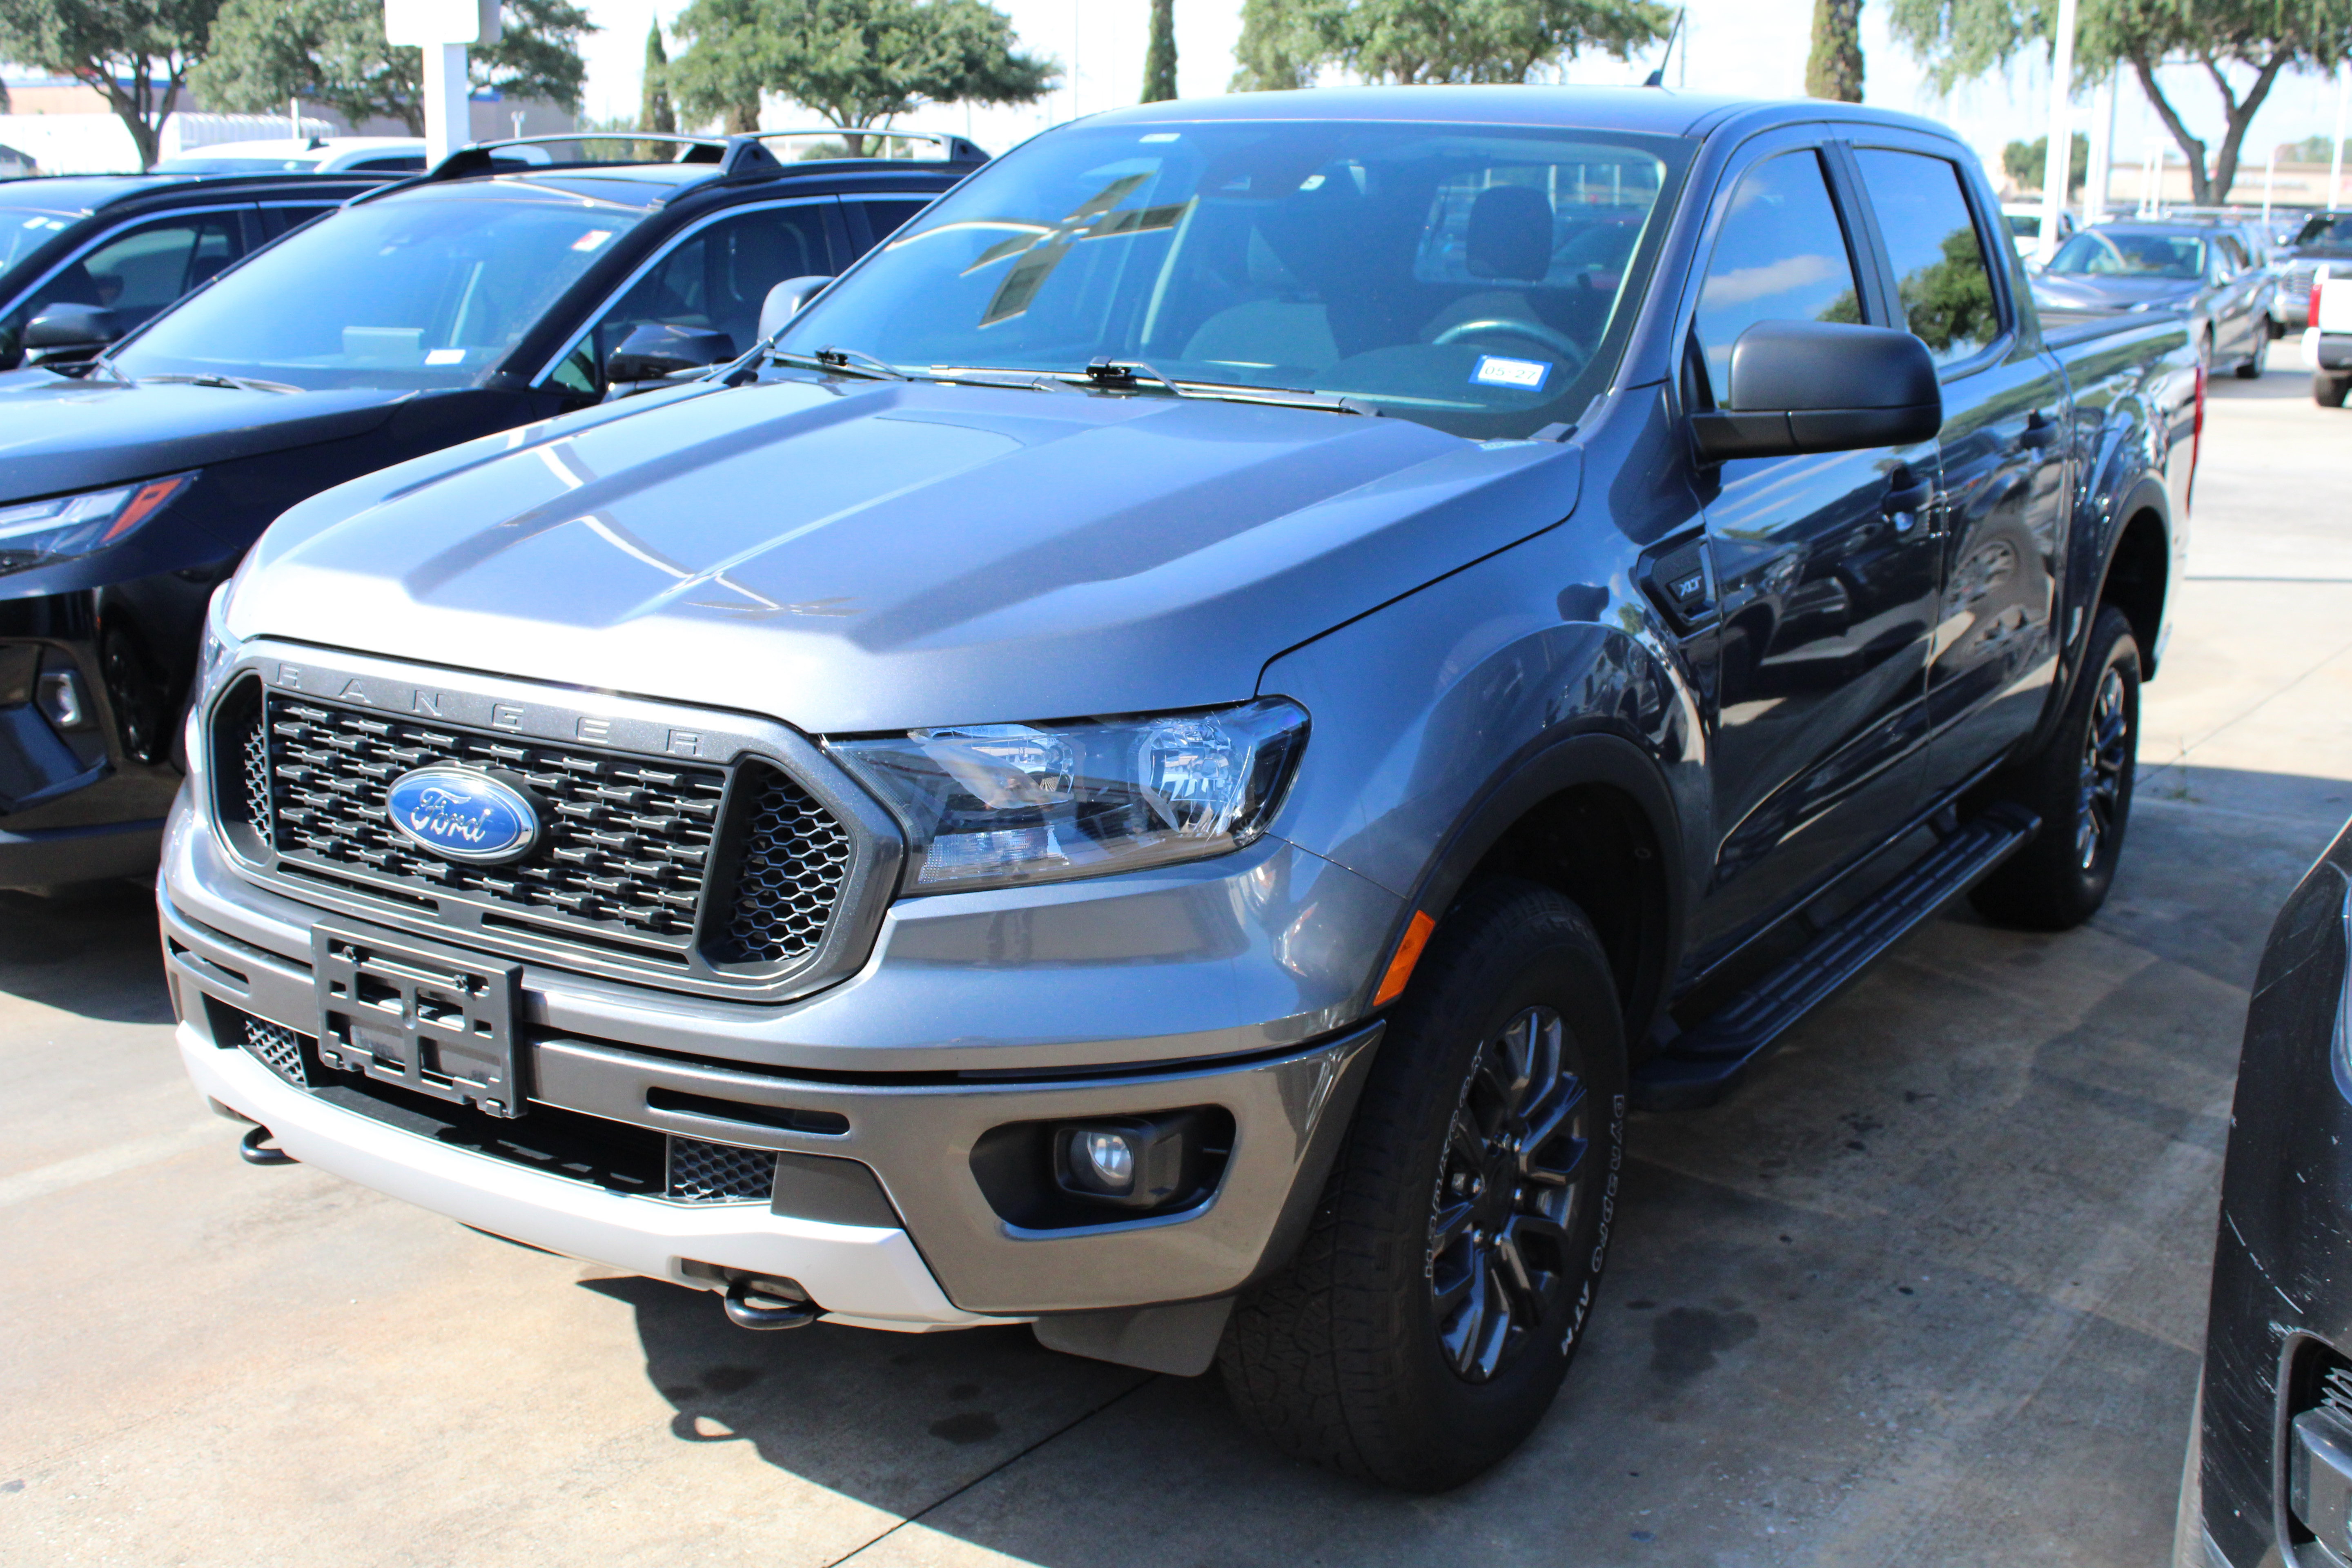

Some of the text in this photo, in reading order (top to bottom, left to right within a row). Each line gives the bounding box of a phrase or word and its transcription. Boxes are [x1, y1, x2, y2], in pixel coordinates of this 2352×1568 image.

[1679, 575, 1702, 596] XLT
[276, 663, 704, 757] RANGER
[410, 786, 491, 843] Ford
